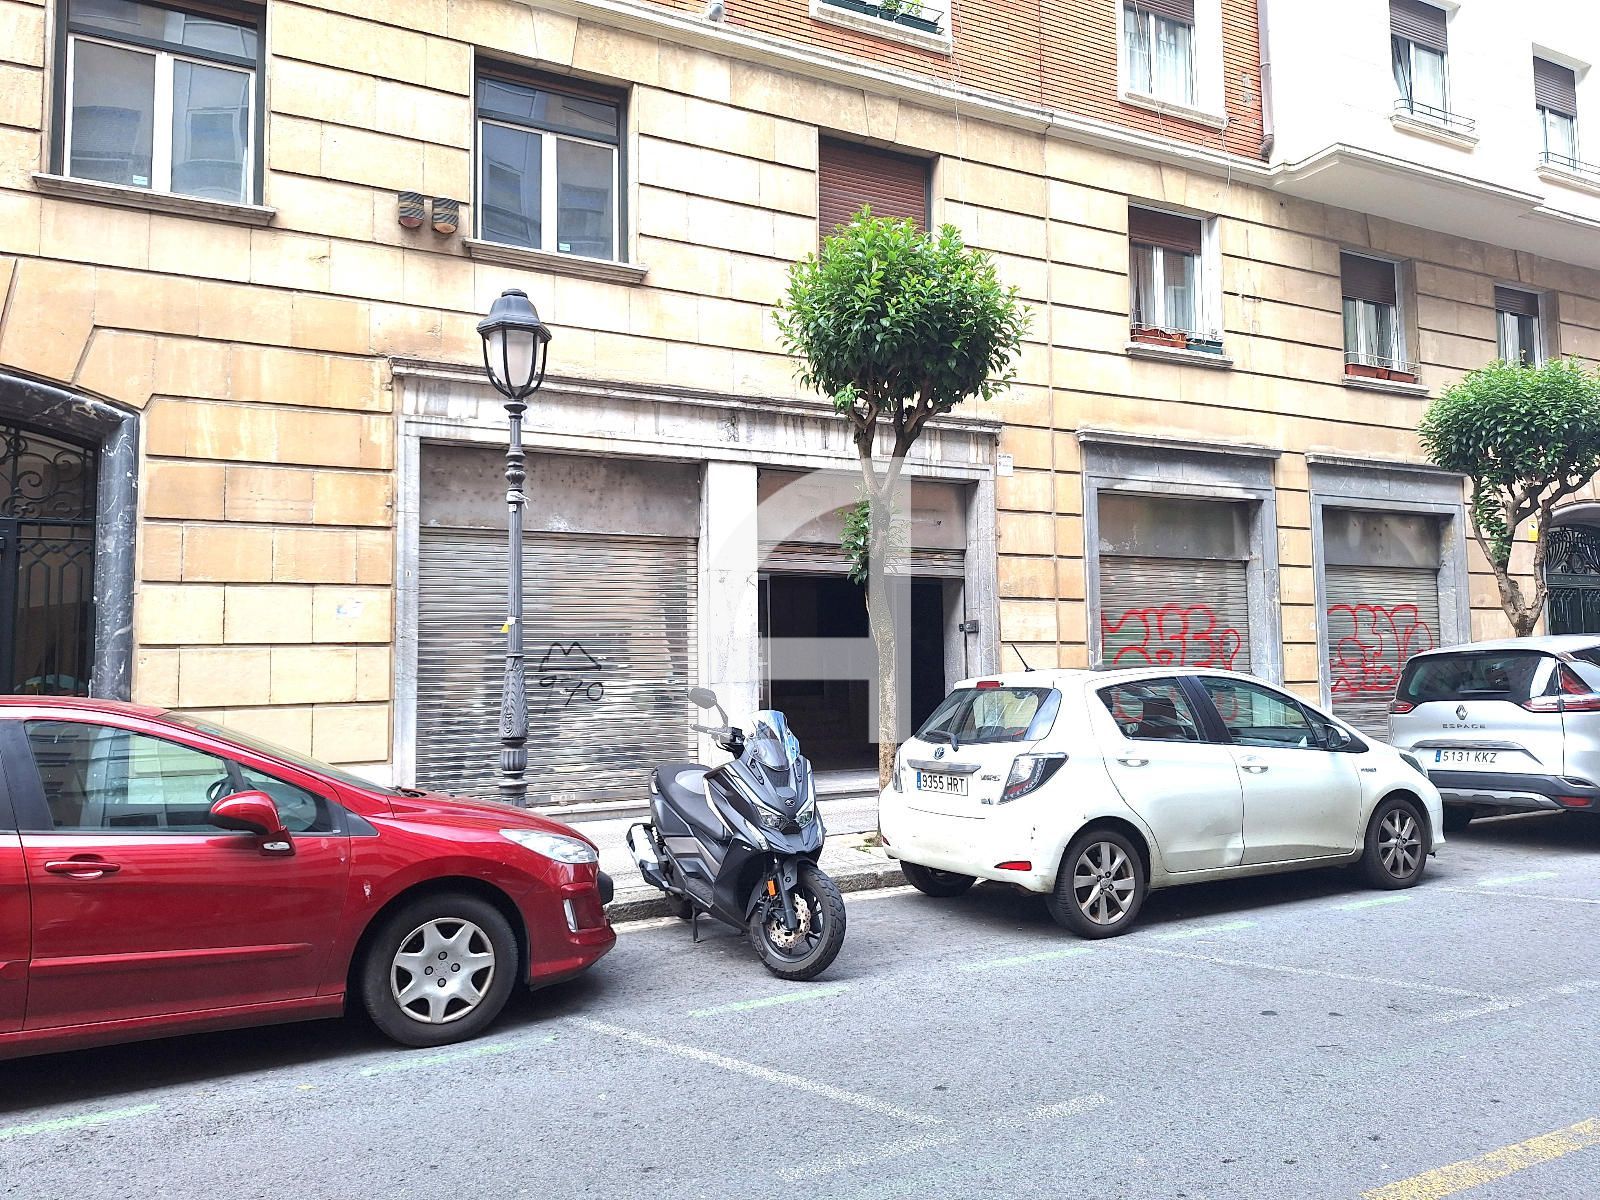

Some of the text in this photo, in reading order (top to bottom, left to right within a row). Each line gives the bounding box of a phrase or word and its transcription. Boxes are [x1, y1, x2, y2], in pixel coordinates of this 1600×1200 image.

[1442, 751, 1497, 763] 5131 KKZ
[922, 774, 965, 792] 9355 HRT
